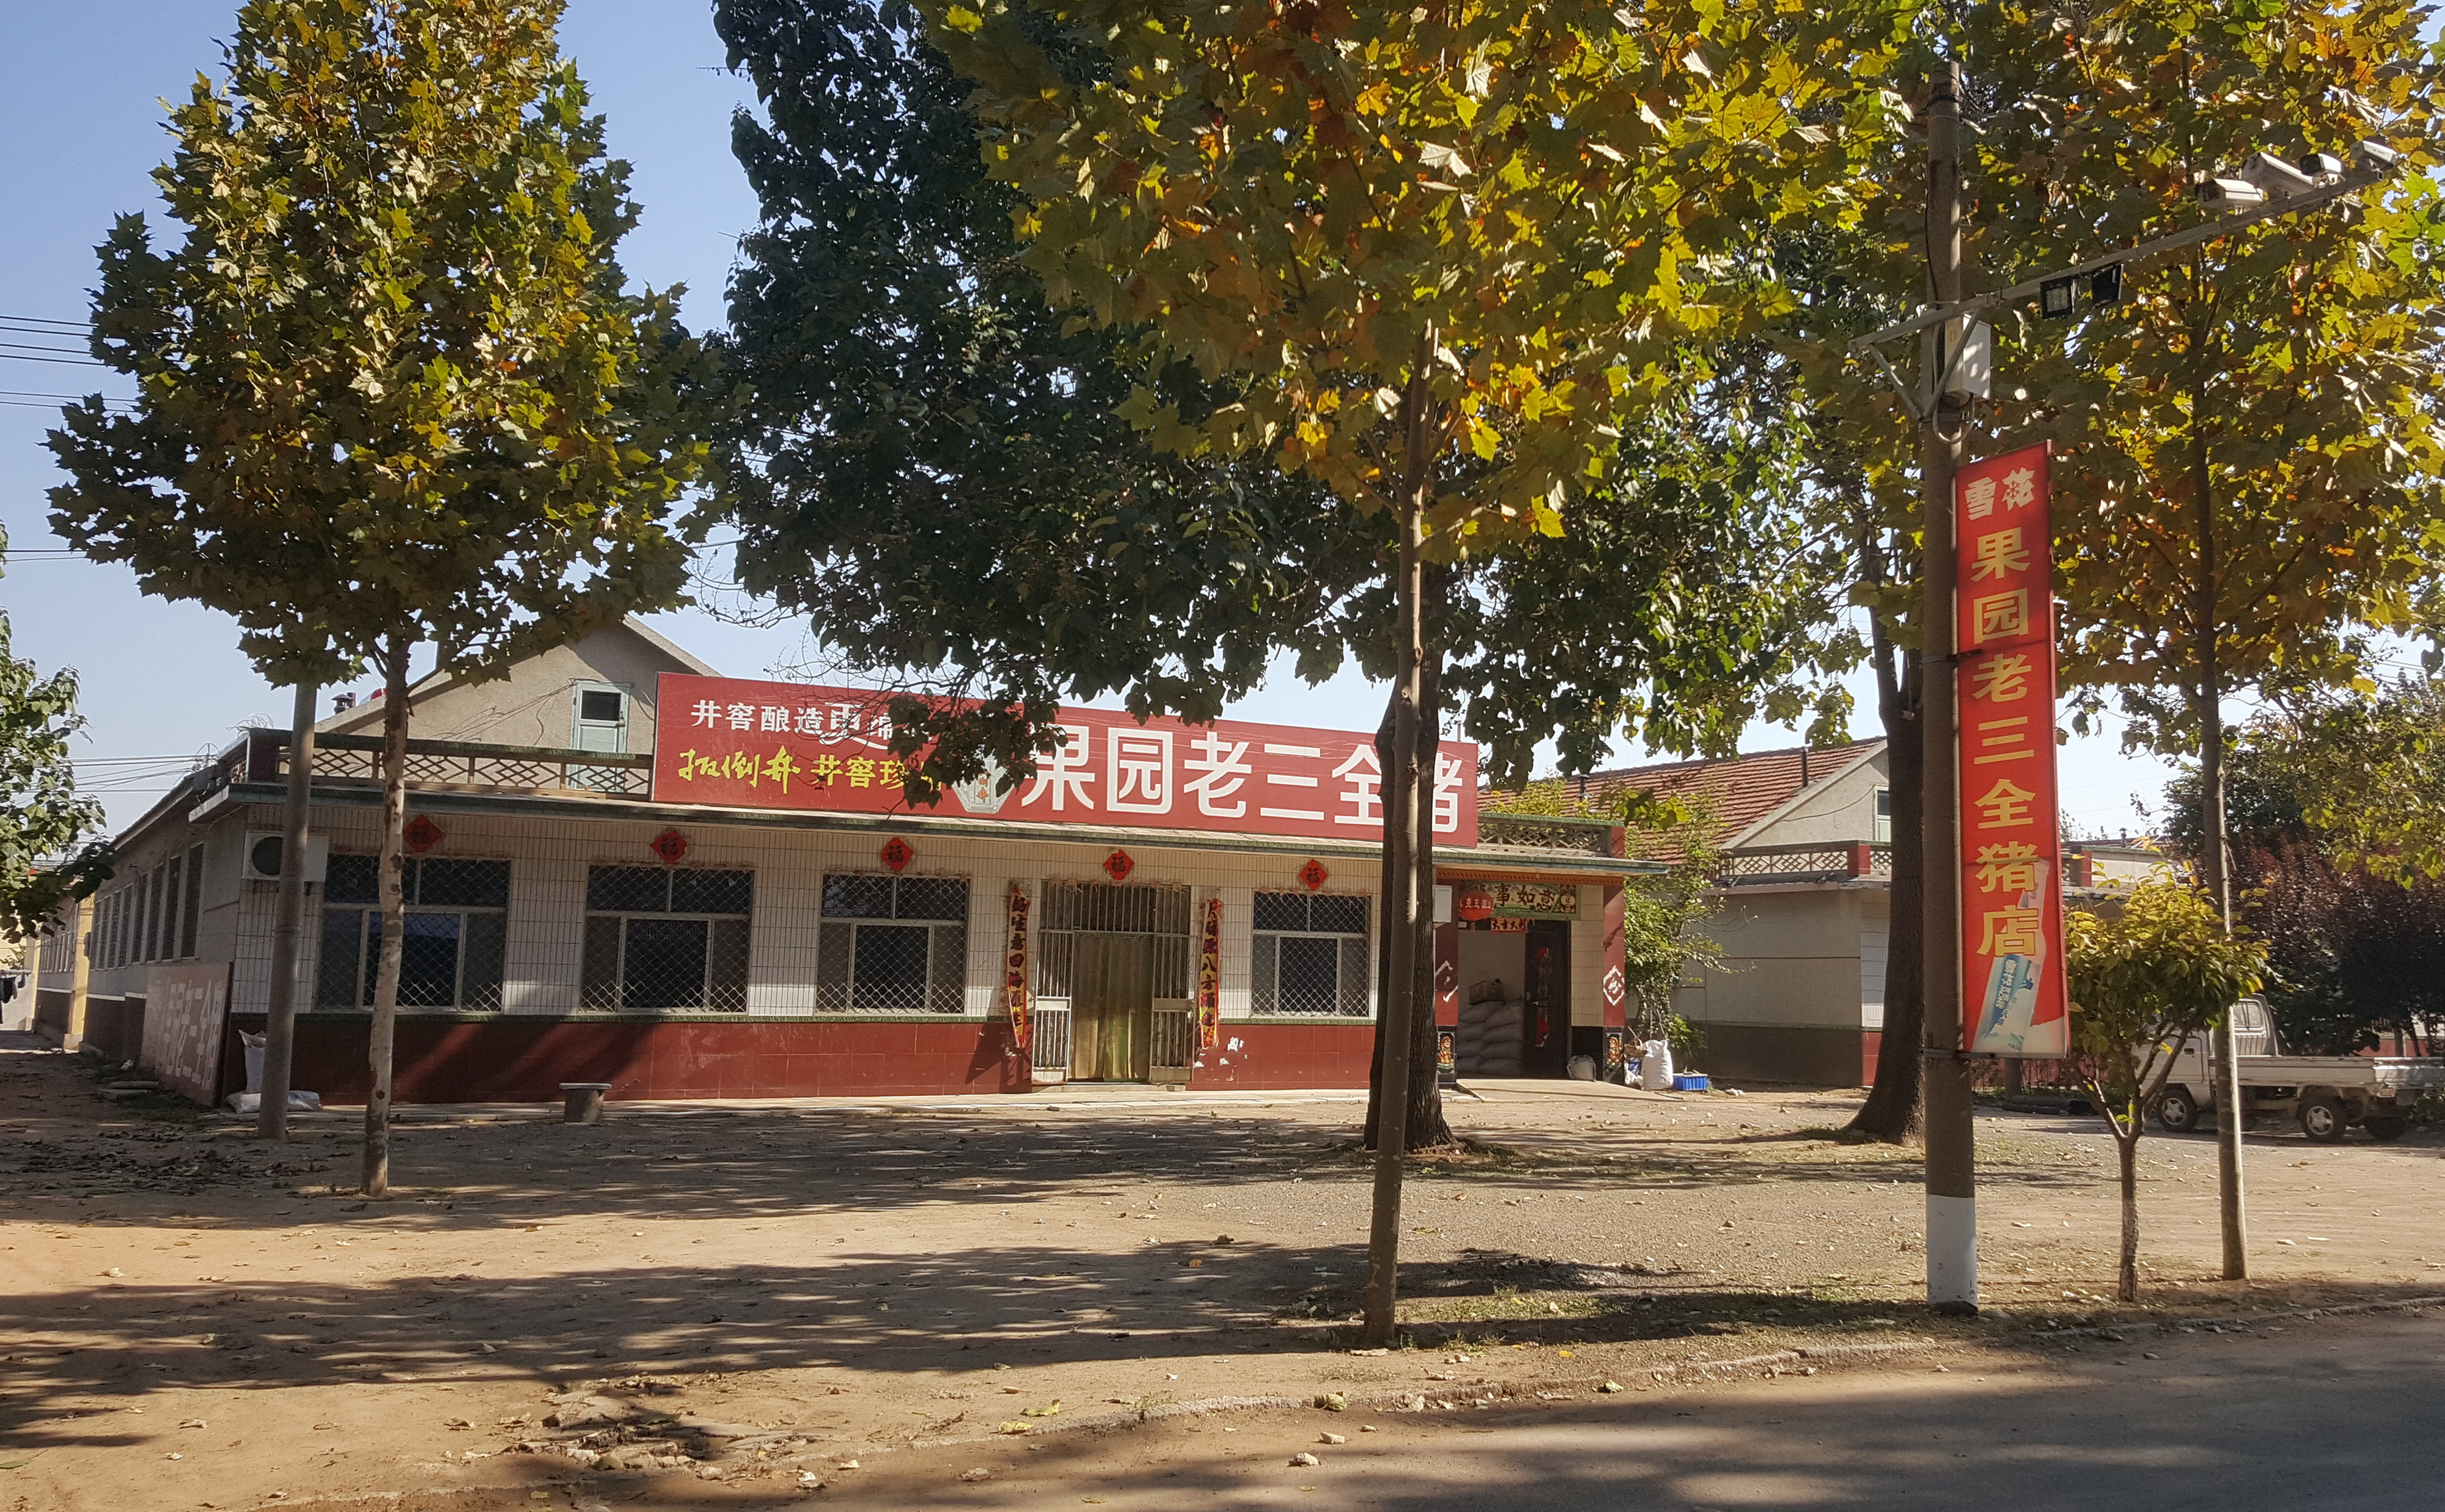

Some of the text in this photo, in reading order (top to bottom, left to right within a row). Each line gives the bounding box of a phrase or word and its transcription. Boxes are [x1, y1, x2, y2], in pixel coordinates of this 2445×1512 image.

[1964, 466, 2036, 521] 雪花
[691, 698, 933, 750] 井窖酿造更绵
[1970, 526, 2040, 957] 果园老三全猪店
[811, 754, 942, 791] 井窖珍
[661, 836, 679, 855] 福
[887, 845, 904, 862] 福
[1110, 856, 1127, 872] 福
[1306, 867, 1320, 883] 福
